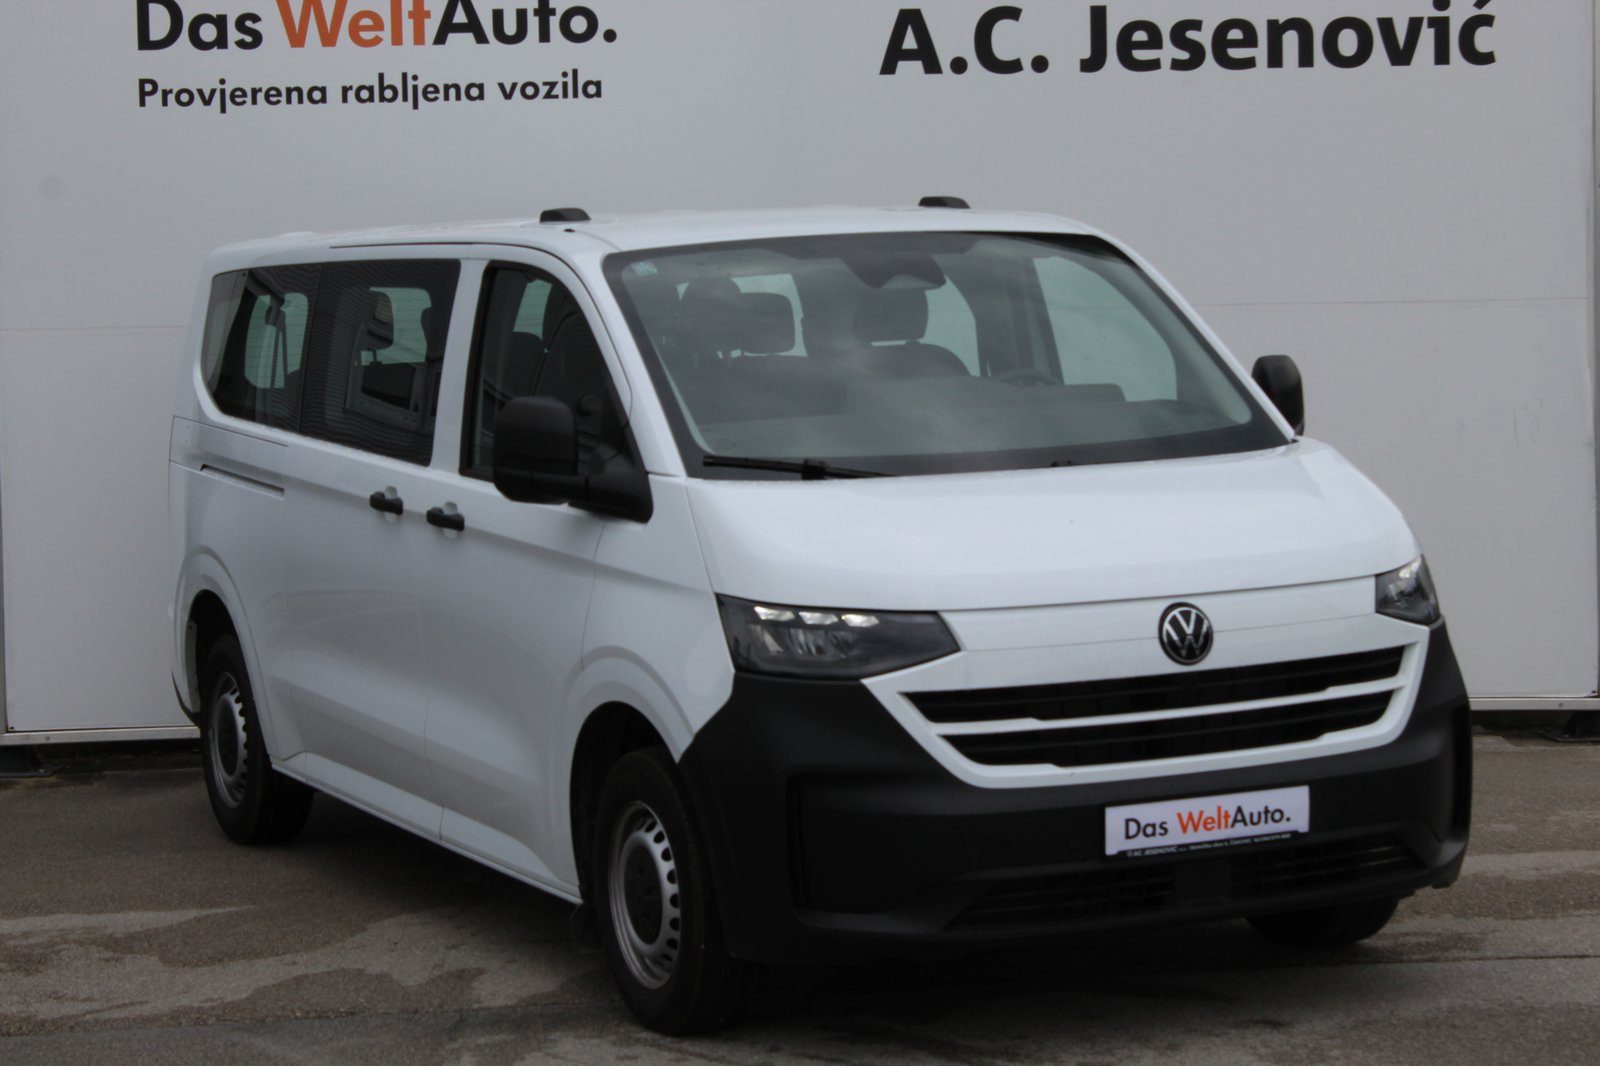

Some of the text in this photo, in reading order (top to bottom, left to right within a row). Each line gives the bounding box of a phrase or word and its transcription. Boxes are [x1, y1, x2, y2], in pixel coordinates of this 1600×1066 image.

[136, 0, 617, 51] Das WeltAuto.
[879, 0, 1496, 75] A.C. Jesenović
[138, 68, 602, 114] Provjerena rabljena vozila
[1124, 805, 1291, 840] Das WeltAuto.
